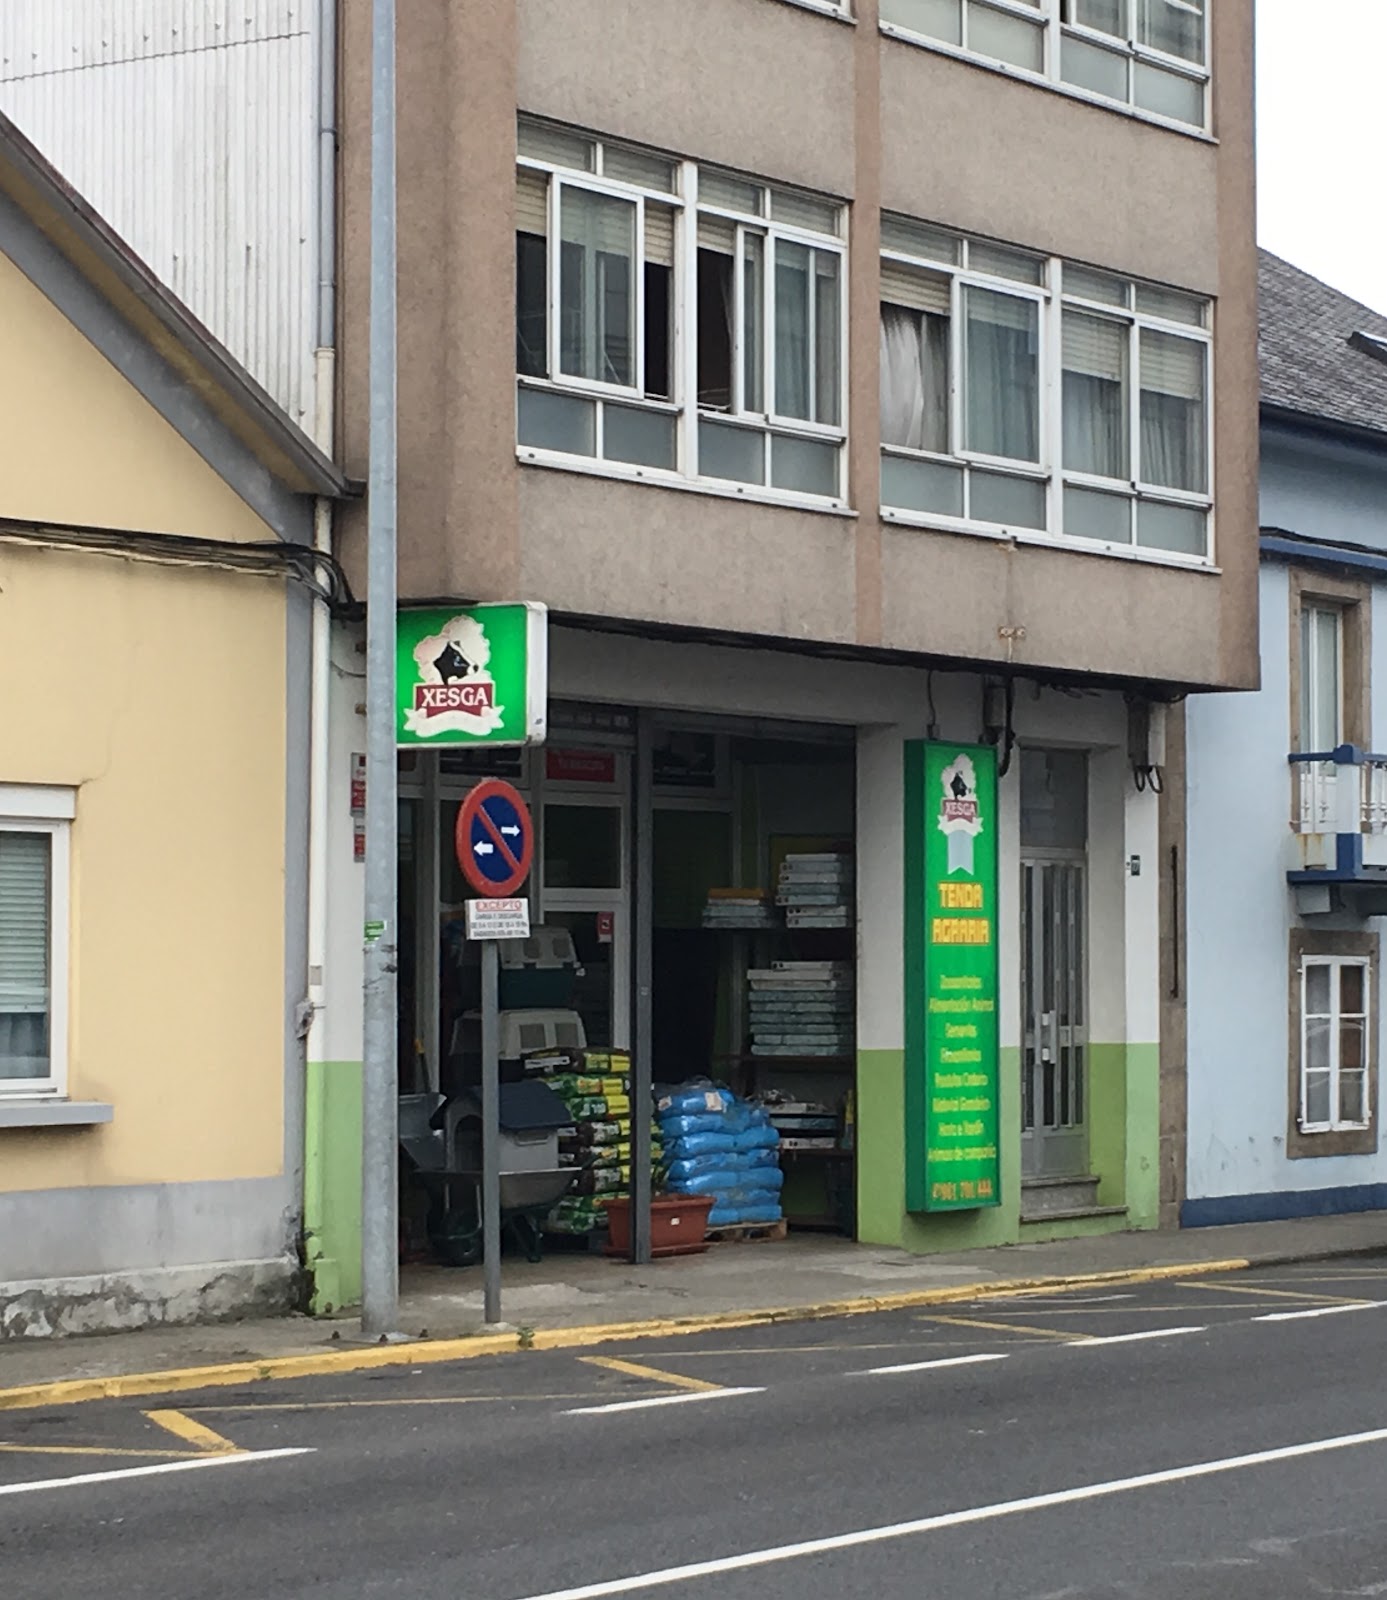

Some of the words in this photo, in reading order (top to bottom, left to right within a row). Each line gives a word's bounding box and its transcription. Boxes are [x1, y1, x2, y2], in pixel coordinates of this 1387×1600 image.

[421, 687, 489, 707] XESGA
[944, 801, 976, 816] XESGA
[475, 900, 522, 911] EXCEPTO
[938, 882, 983, 909] TENDA
[933, 917, 989, 944] AGRARIA
